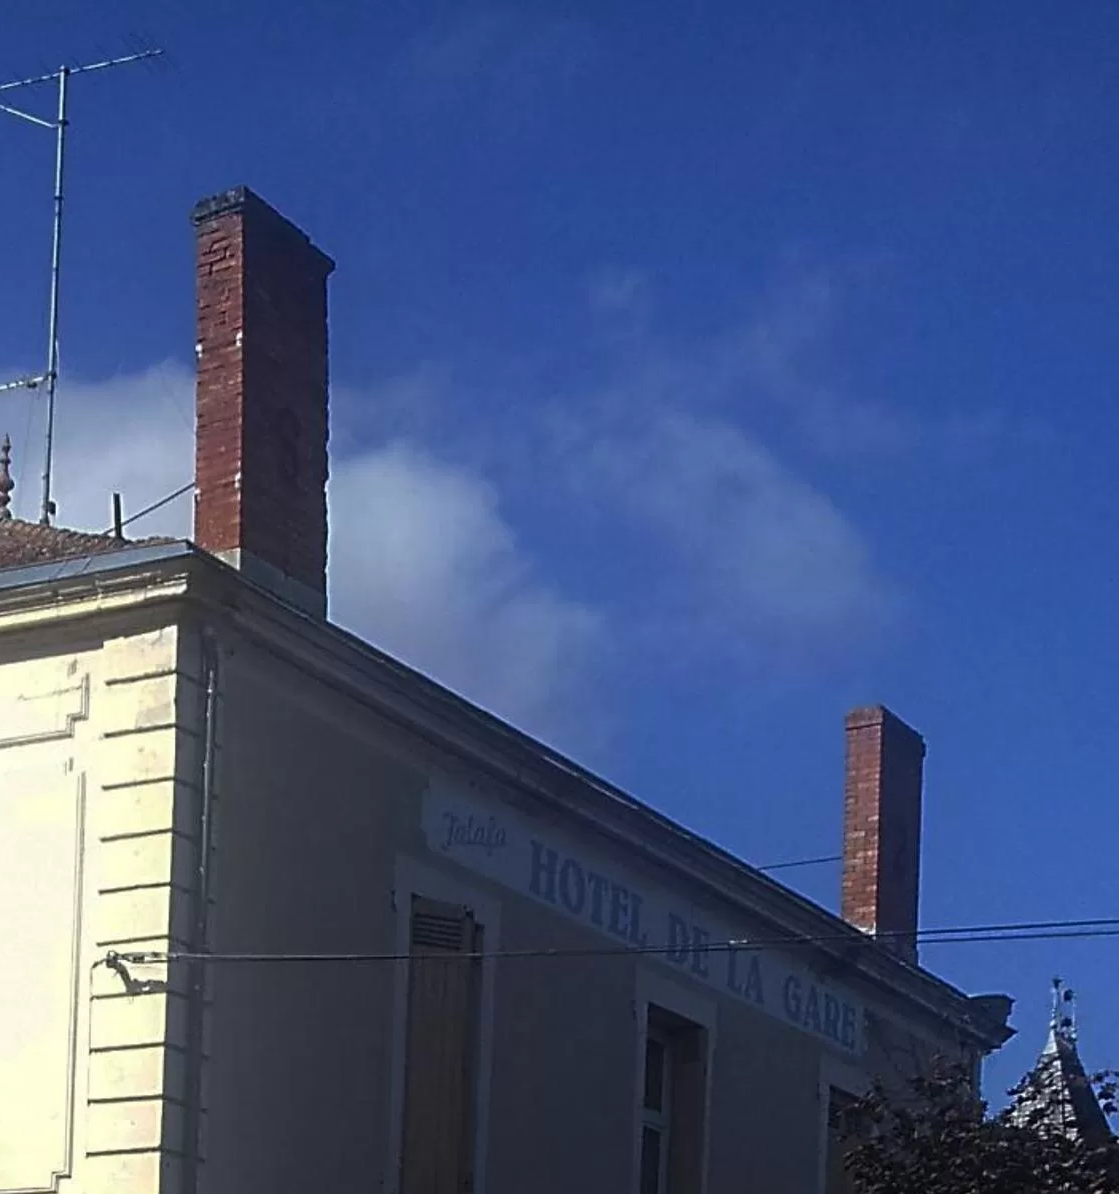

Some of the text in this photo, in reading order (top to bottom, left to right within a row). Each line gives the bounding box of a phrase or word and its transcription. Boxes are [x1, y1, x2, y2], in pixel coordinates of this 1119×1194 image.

[529, 839, 858, 1052] HOTEL DE LA GARE
